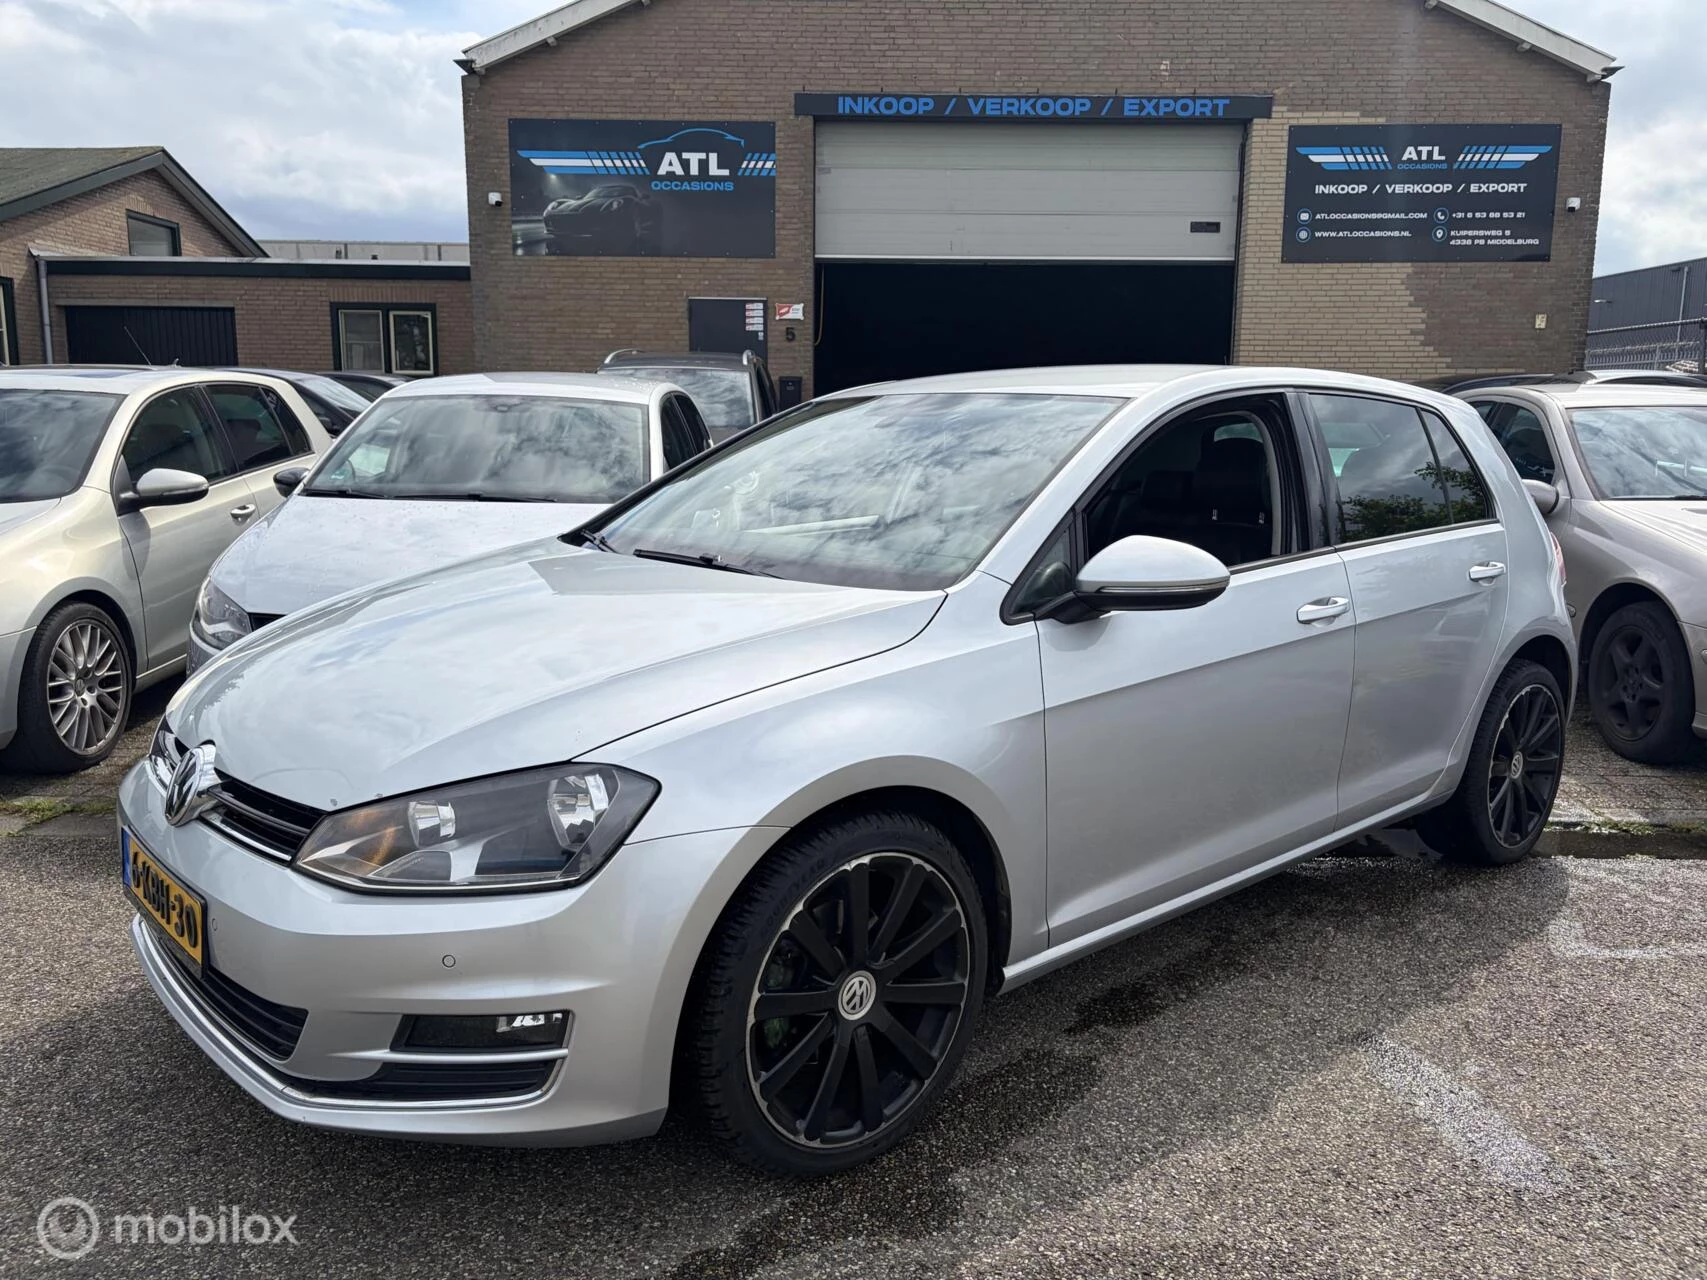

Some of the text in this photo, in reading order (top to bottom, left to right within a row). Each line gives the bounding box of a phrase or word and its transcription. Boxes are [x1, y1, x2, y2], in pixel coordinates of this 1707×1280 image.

[838, 96, 1231, 118] INKOOP / VERKOOP / EXPORT
[1401, 145, 1446, 161] ATL
[656, 151, 730, 176] ATL
[1396, 162, 1449, 171] OCCASIONS
[651, 180, 734, 191] OCCASIONS
[1314, 184, 1368, 195] INKOOP
[1385, 183, 1453, 194] VERKOOP
[1469, 182, 1528, 193] EXPORT
[1314, 229, 1412, 238] WWW.ATLOCCASIONS.NL
[1487, 237, 1540, 246] MIDDELBURG
[785, 327, 796, 342] 5
[131, 851, 199, 949] 6-KBH-30
